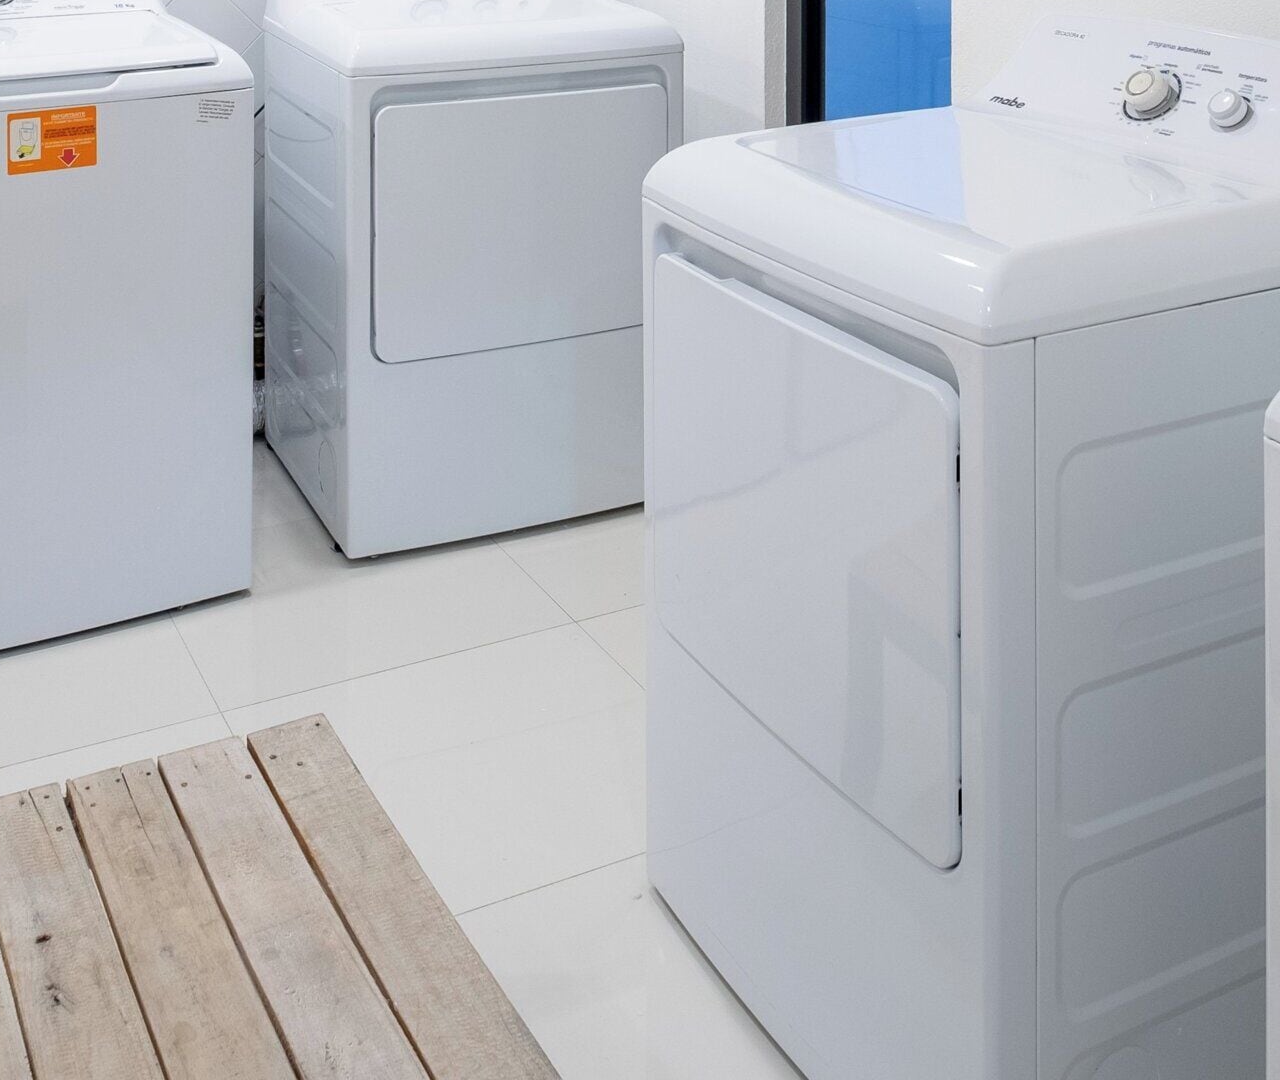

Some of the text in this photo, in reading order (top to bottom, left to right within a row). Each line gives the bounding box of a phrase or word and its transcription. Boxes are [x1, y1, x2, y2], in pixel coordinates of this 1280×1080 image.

[1147, 40, 1211, 56] programas automáticos
[989, 95, 1026, 109] mabe
